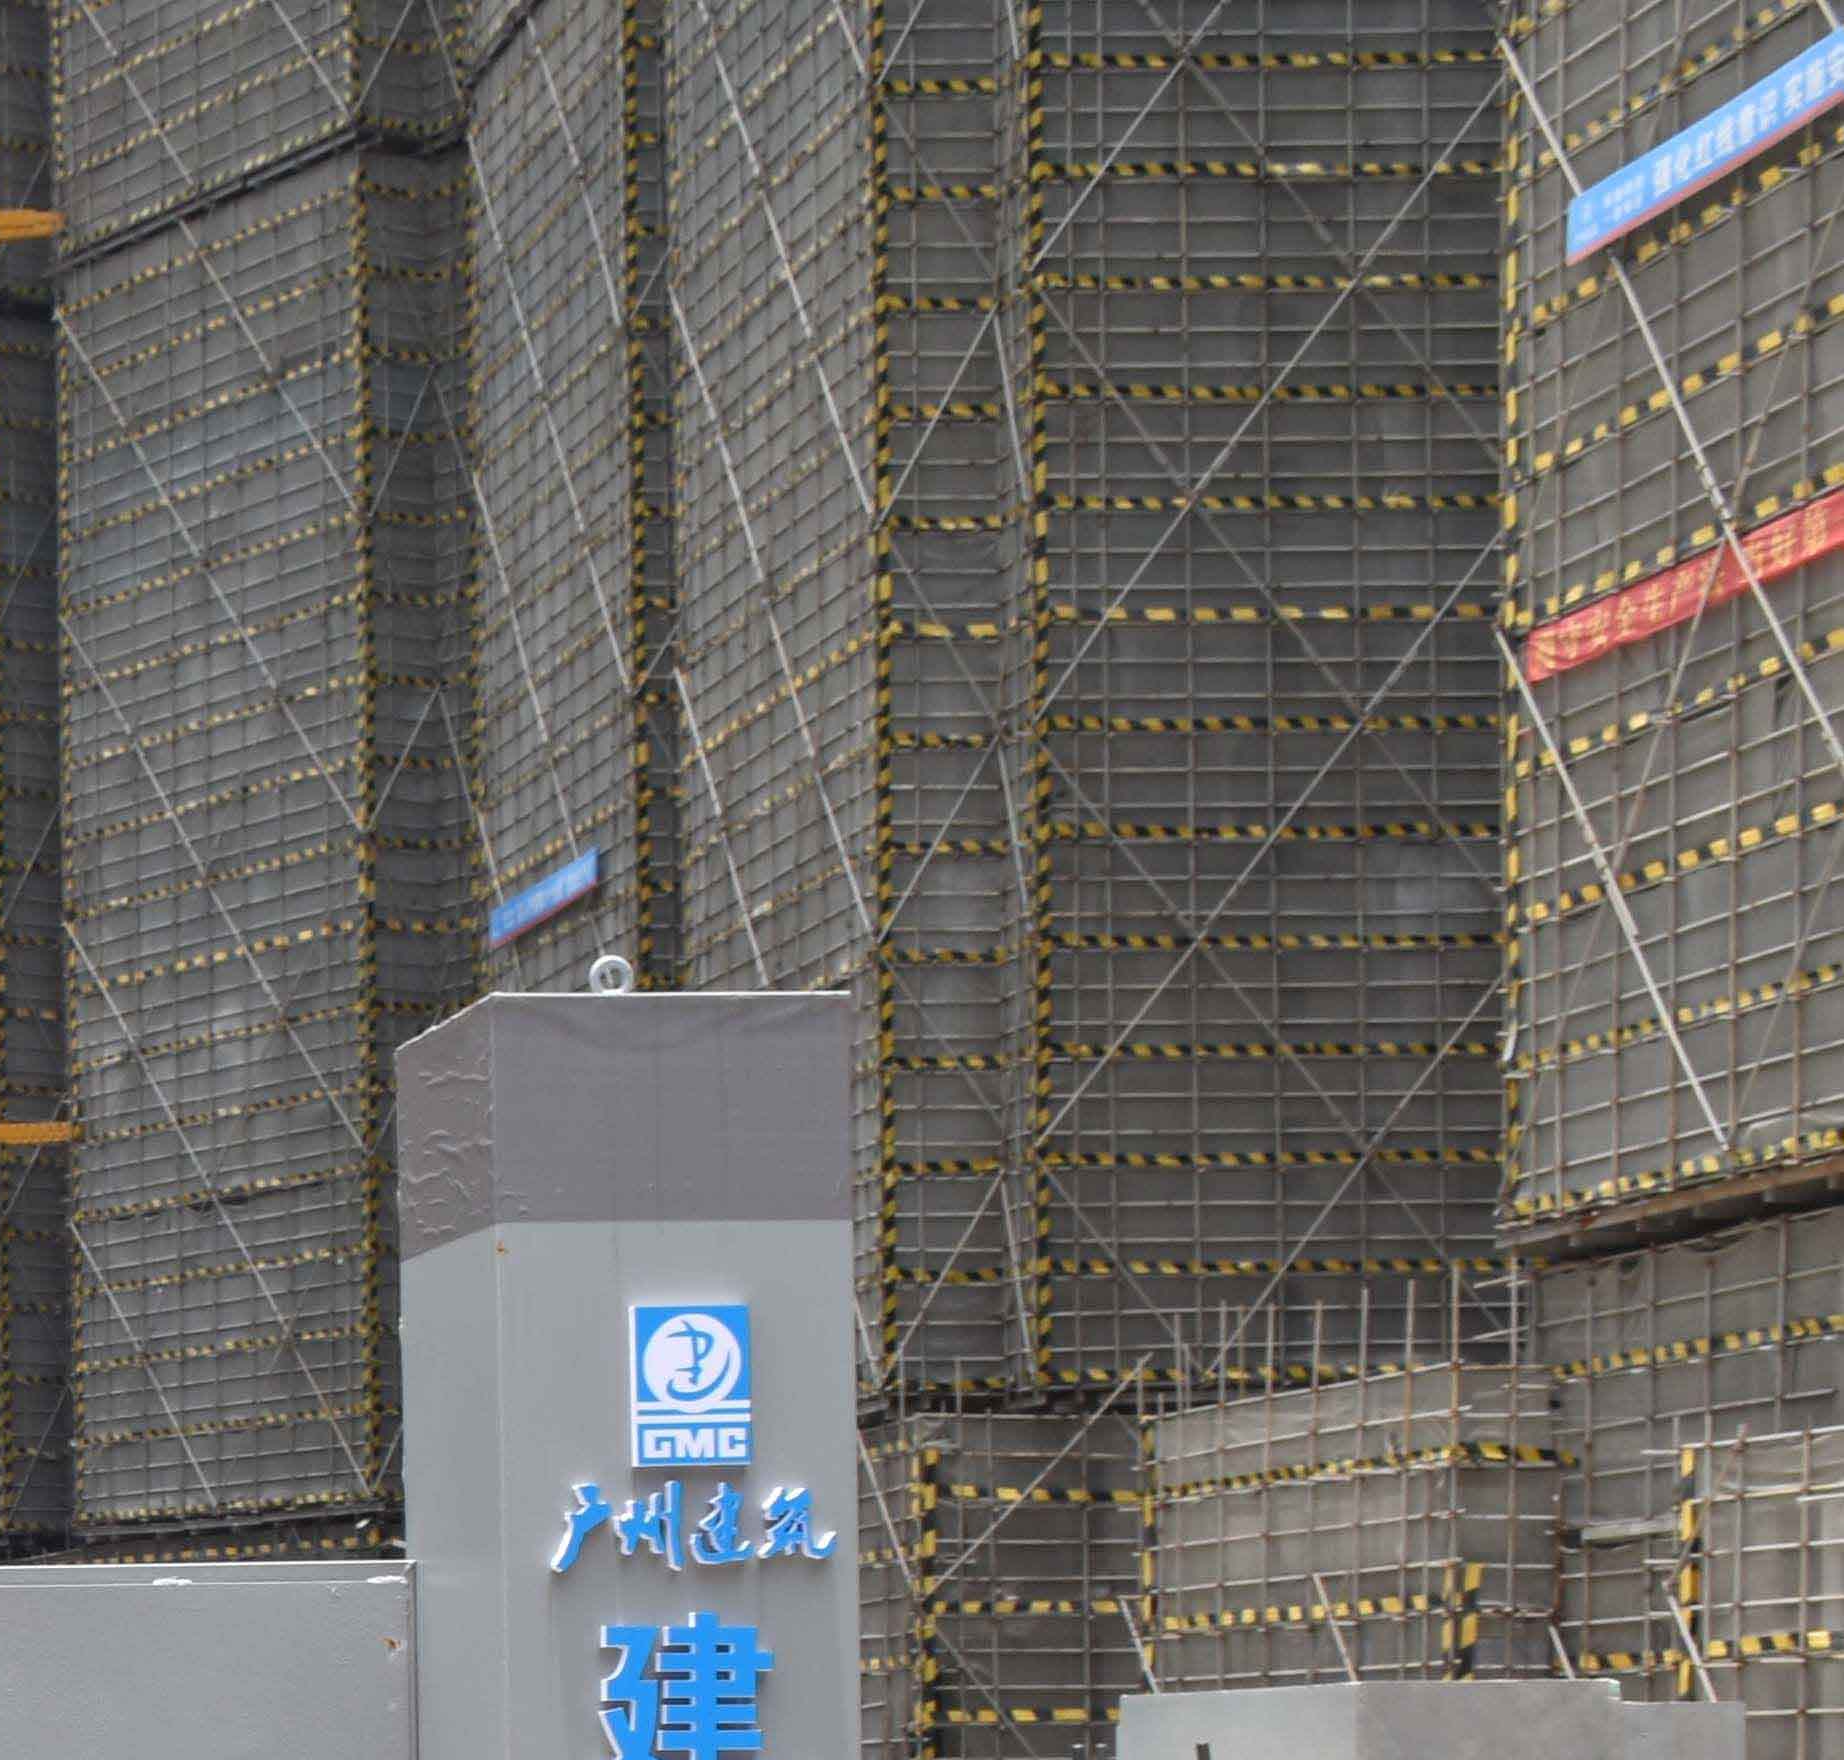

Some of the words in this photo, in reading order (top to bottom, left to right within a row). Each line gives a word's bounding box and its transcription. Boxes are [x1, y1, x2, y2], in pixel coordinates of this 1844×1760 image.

[643, 1427, 748, 1459] GMC
[550, 1479, 838, 1573] 广州建筑
